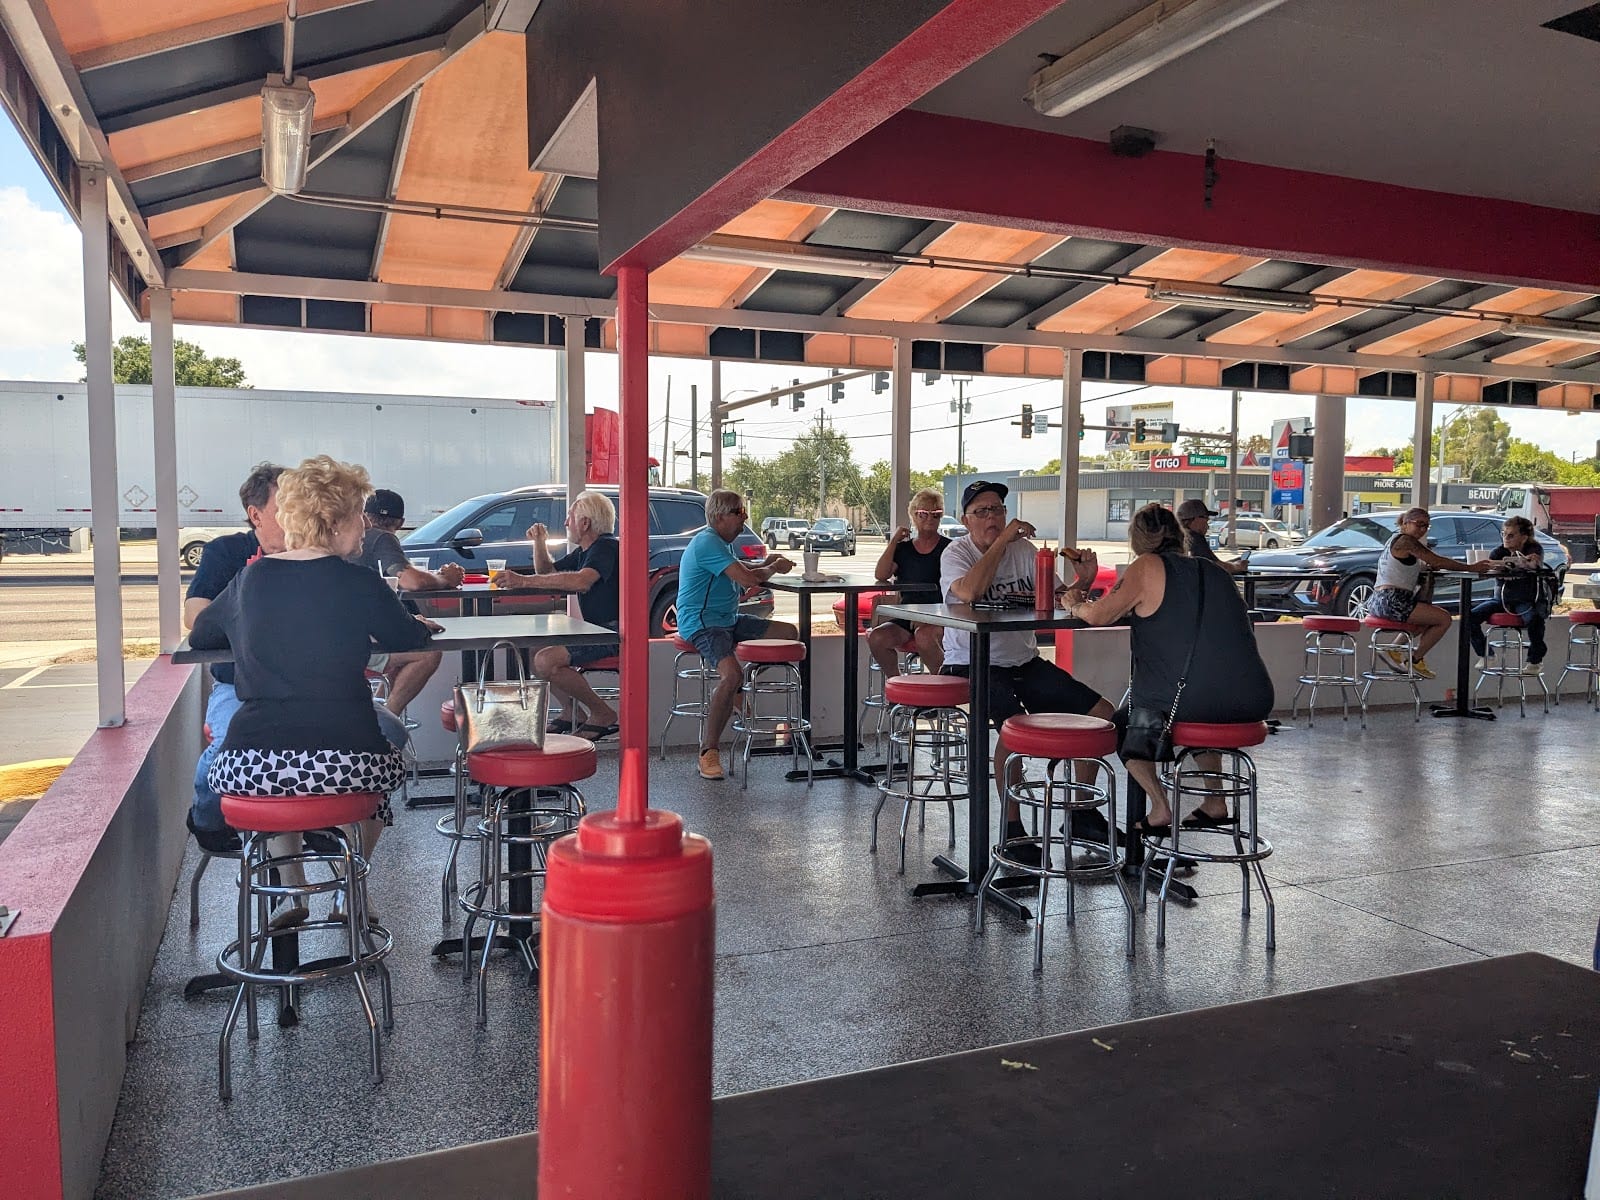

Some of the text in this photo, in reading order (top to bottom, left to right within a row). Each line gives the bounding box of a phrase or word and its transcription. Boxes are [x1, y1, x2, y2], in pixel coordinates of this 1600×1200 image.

[1276, 449, 1289, 457] CIT
[1154, 458, 1180, 469] CITGO
[1195, 456, 1225, 467] Washington
[1373, 480, 1394, 488] PHONE
